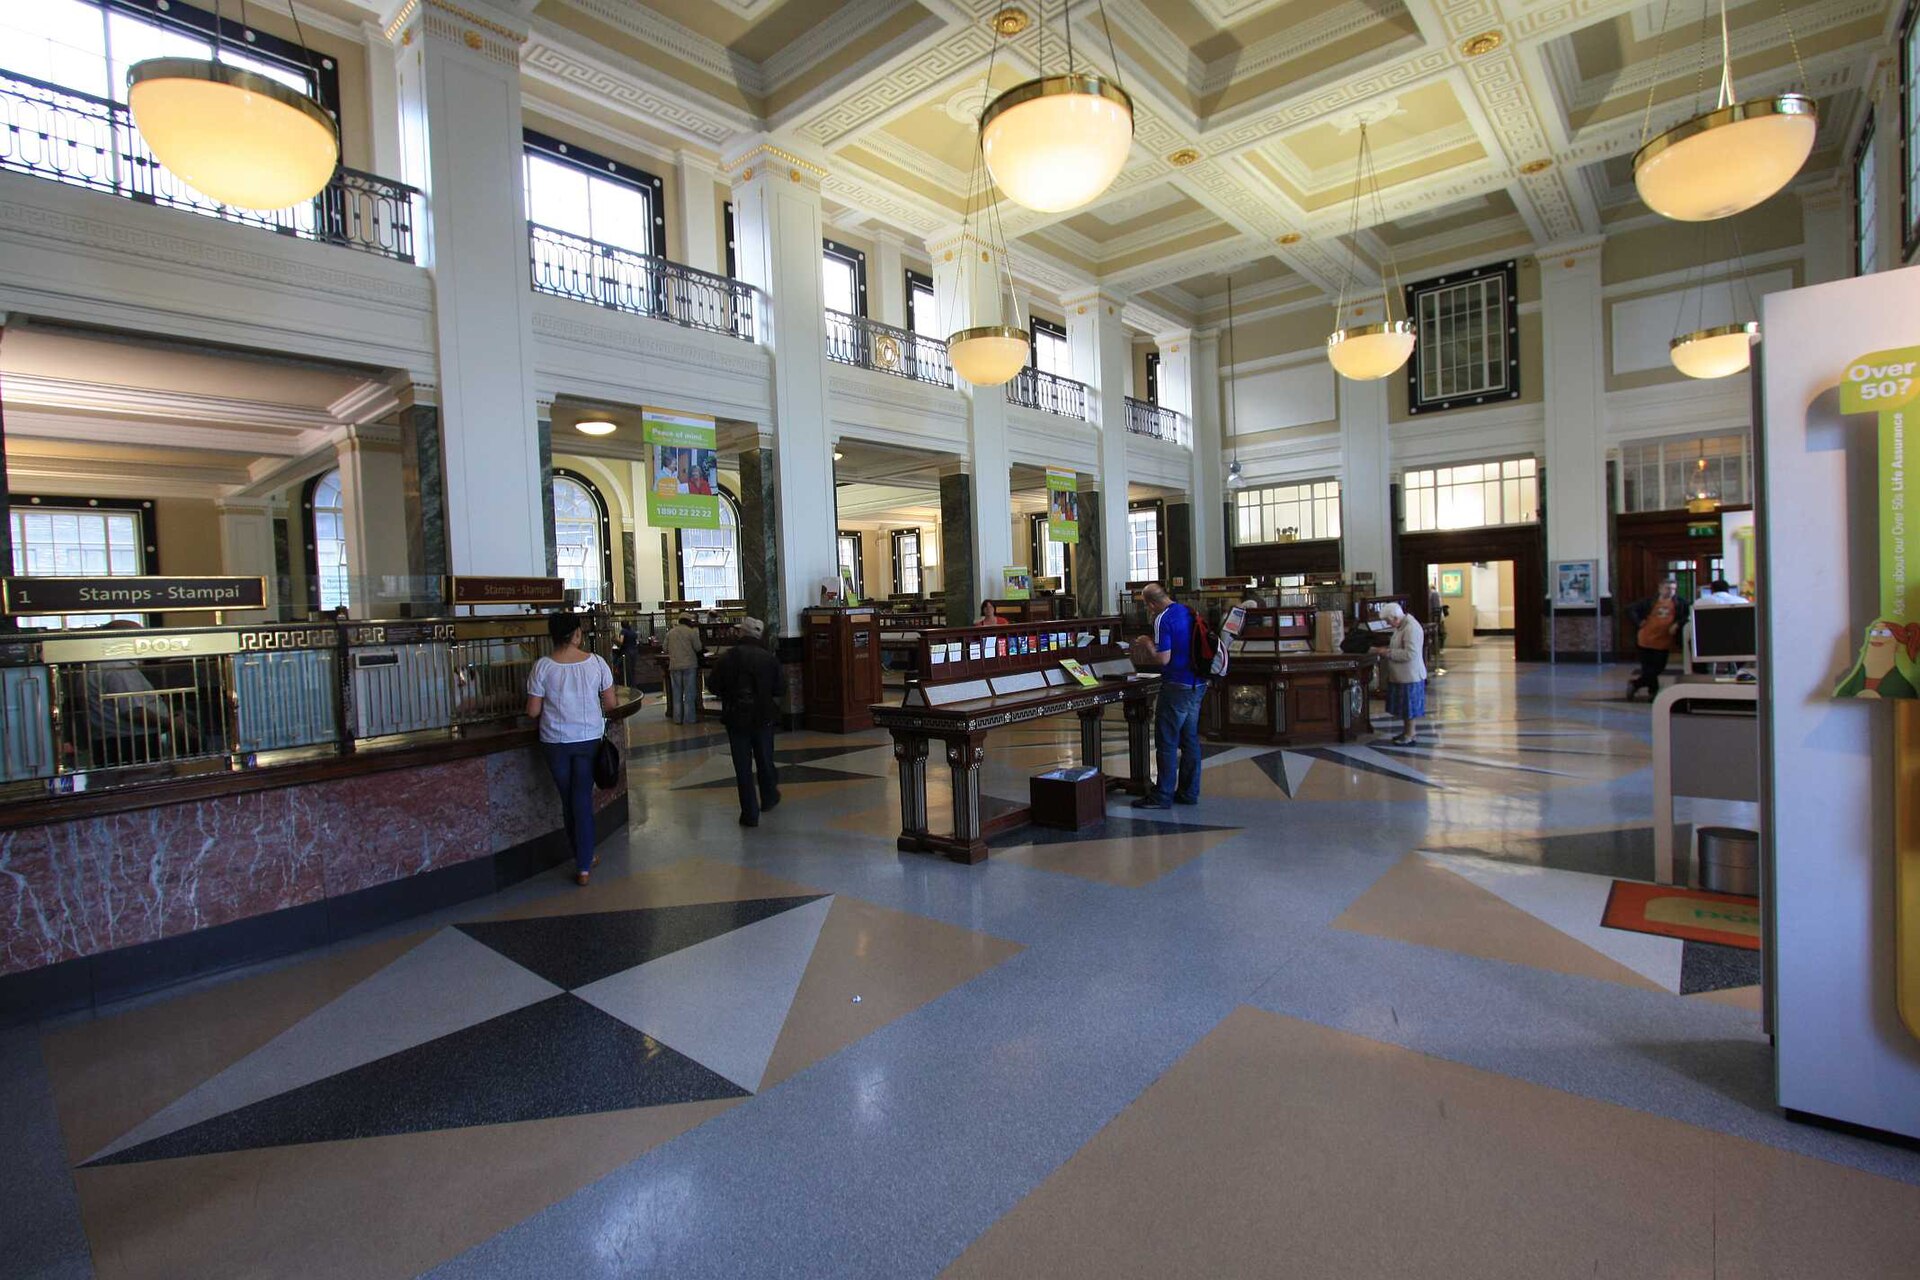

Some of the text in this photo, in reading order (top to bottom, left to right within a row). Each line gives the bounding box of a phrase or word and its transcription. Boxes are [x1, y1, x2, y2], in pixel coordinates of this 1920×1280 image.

[1849, 362, 1916, 382] Over
[1861, 378, 1912, 400] 50?
[1891, 412, 1904, 468] Assurance
[1891, 470, 1904, 491] Life
[1892, 512, 1905, 535] Over
[18, 590, 32, 604] 1
[79, 587, 152, 604] Stamps
[484, 584, 516, 598] Stamps
